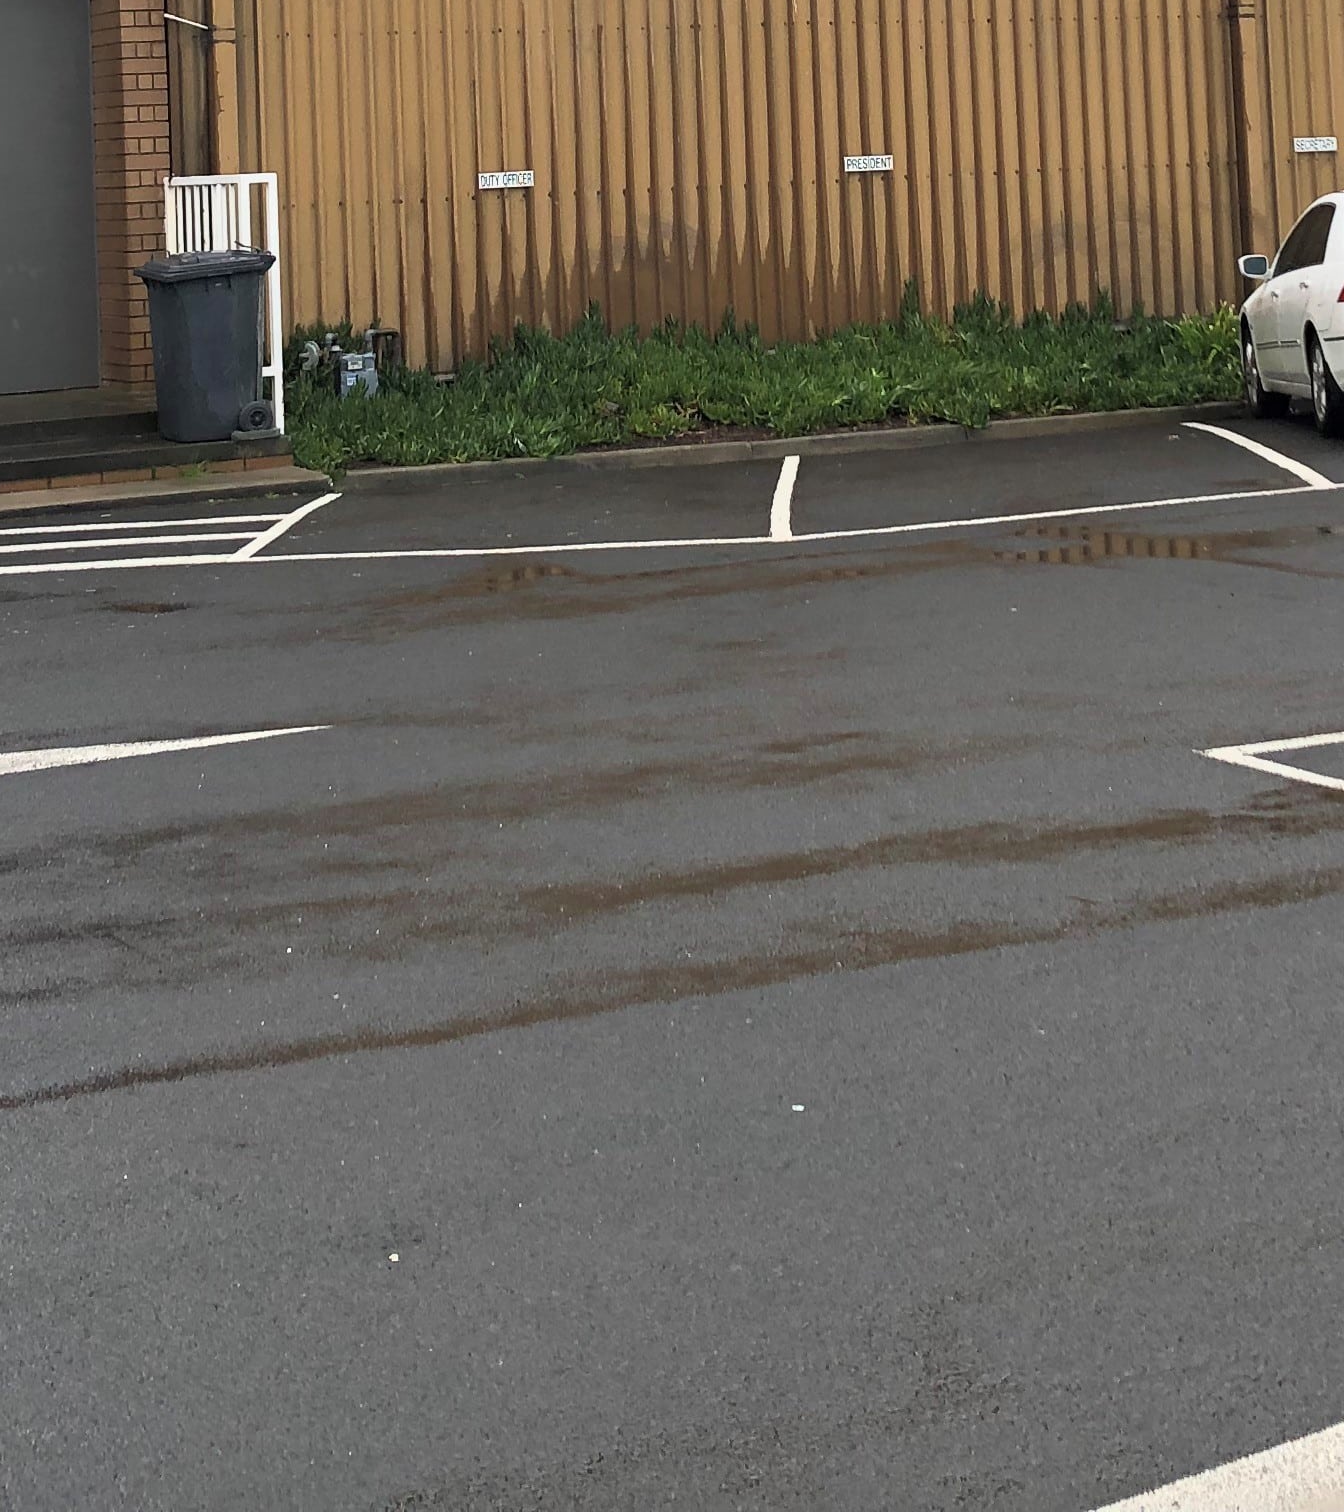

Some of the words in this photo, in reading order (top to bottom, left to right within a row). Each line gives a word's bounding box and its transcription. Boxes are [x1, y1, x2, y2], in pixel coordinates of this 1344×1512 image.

[846, 157, 892, 170] PRESIDENT
[480, 175, 500, 187] DUTY
[502, 172, 532, 186] OFFICER
